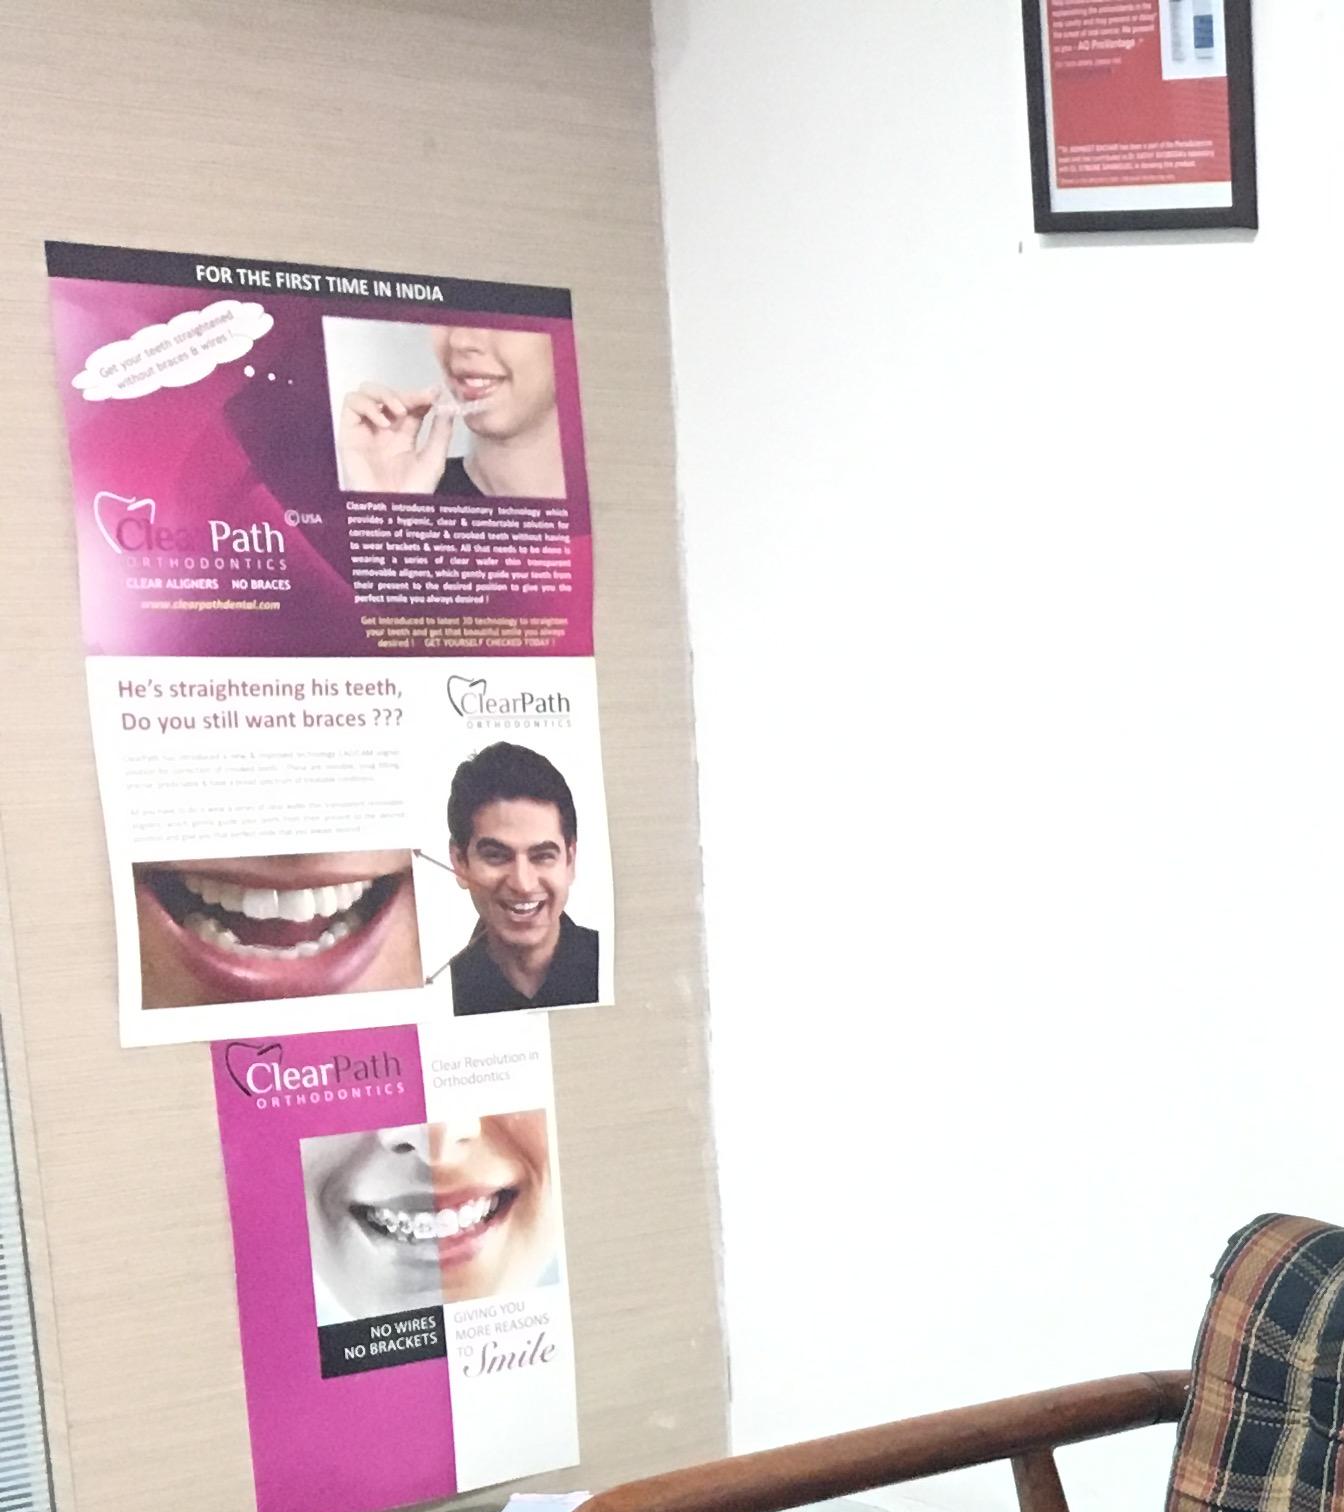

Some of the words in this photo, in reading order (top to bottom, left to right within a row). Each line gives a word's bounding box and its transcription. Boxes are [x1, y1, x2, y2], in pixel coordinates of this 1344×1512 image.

[195, 264, 233, 284] FOR
[236, 268, 272, 287] THE
[275, 271, 322, 291] FIRST
[325, 276, 369, 296] TIME
[373, 280, 392, 298] IN
[396, 282, 444, 302] INDIA
[120, 353, 142, 371] your
[144, 339, 173, 357] teeth
[173, 310, 235, 345] straightened
[117, 367, 155, 390] without
[156, 351, 190, 371] braces
[301, 513, 323, 525] USA
[126, 557, 288, 571] ORTHODONTICS
[126, 578, 163, 590] CLEAR
[166, 578, 219, 590] ALIGNERS
[232, 579, 249, 590] NO
[251, 579, 291, 591] BRACES
[118, 679, 163, 698] He's
[169, 679, 306, 702] straightening
[311, 679, 340, 697] his
[345, 678, 403, 700] teeth,
[460, 692, 570, 715] ClearPath
[121, 712, 151, 731] Do
[157, 714, 196, 735] you
[203, 710, 239, 729] still
[245, 712, 297, 729] want
[303, 709, 367, 728] braces
[372, 708, 404, 727] ???
[466, 720, 572, 729] ORTHODONTICS
[246, 1052, 401, 1094] ClearPath
[431, 1060, 461, 1073] Clear
[464, 1053, 527, 1069] Revolution
[433, 1071, 511, 1088] Orthodontics
[256, 1082, 405, 1110] ORTHODONTICS
[453, 1305, 497, 1324] GIVING
[499, 1301, 525, 1315] YOU
[370, 1324, 392, 1339] NO
[394, 1316, 437, 1334] WIRES
[455, 1324, 492, 1341] MORE
[495, 1312, 550, 1333] REASONS
[344, 1345, 366, 1361] NO
[369, 1331, 438, 1356] BRACKETS
[457, 1346, 474, 1358] TO
[463, 1331, 556, 1378] Smile
